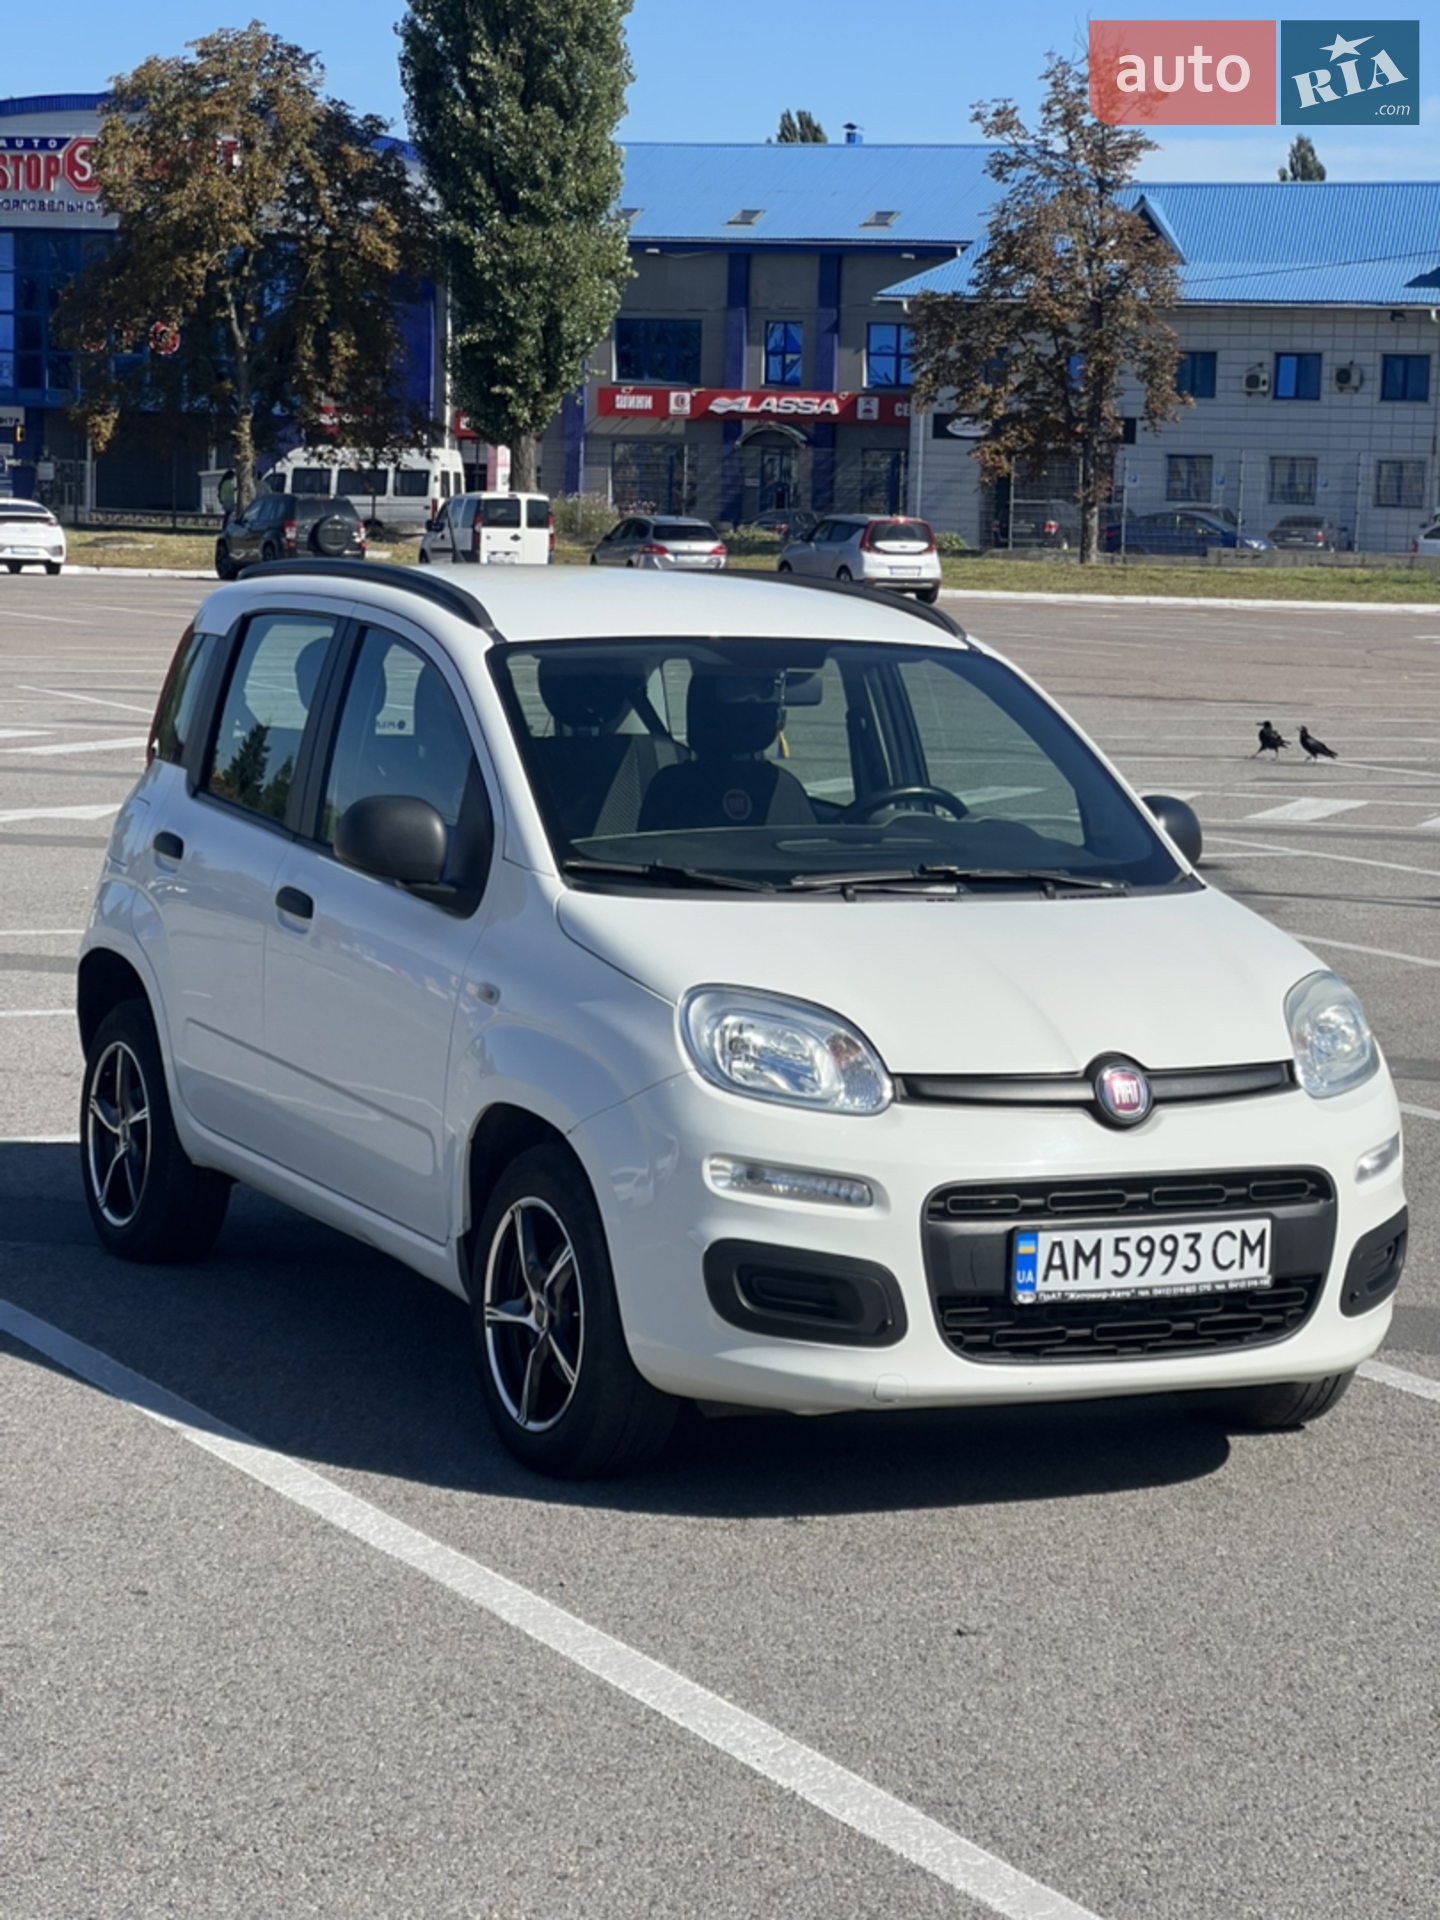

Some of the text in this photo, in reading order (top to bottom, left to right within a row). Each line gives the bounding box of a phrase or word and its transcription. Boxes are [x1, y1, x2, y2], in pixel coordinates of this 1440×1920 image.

[738, 396, 840, 415] LASSA
[1112, 1080, 1139, 1105] FIAT
[1042, 1228, 1267, 1282] AM 5993 CM
[1016, 1269, 1035, 1284] UA
